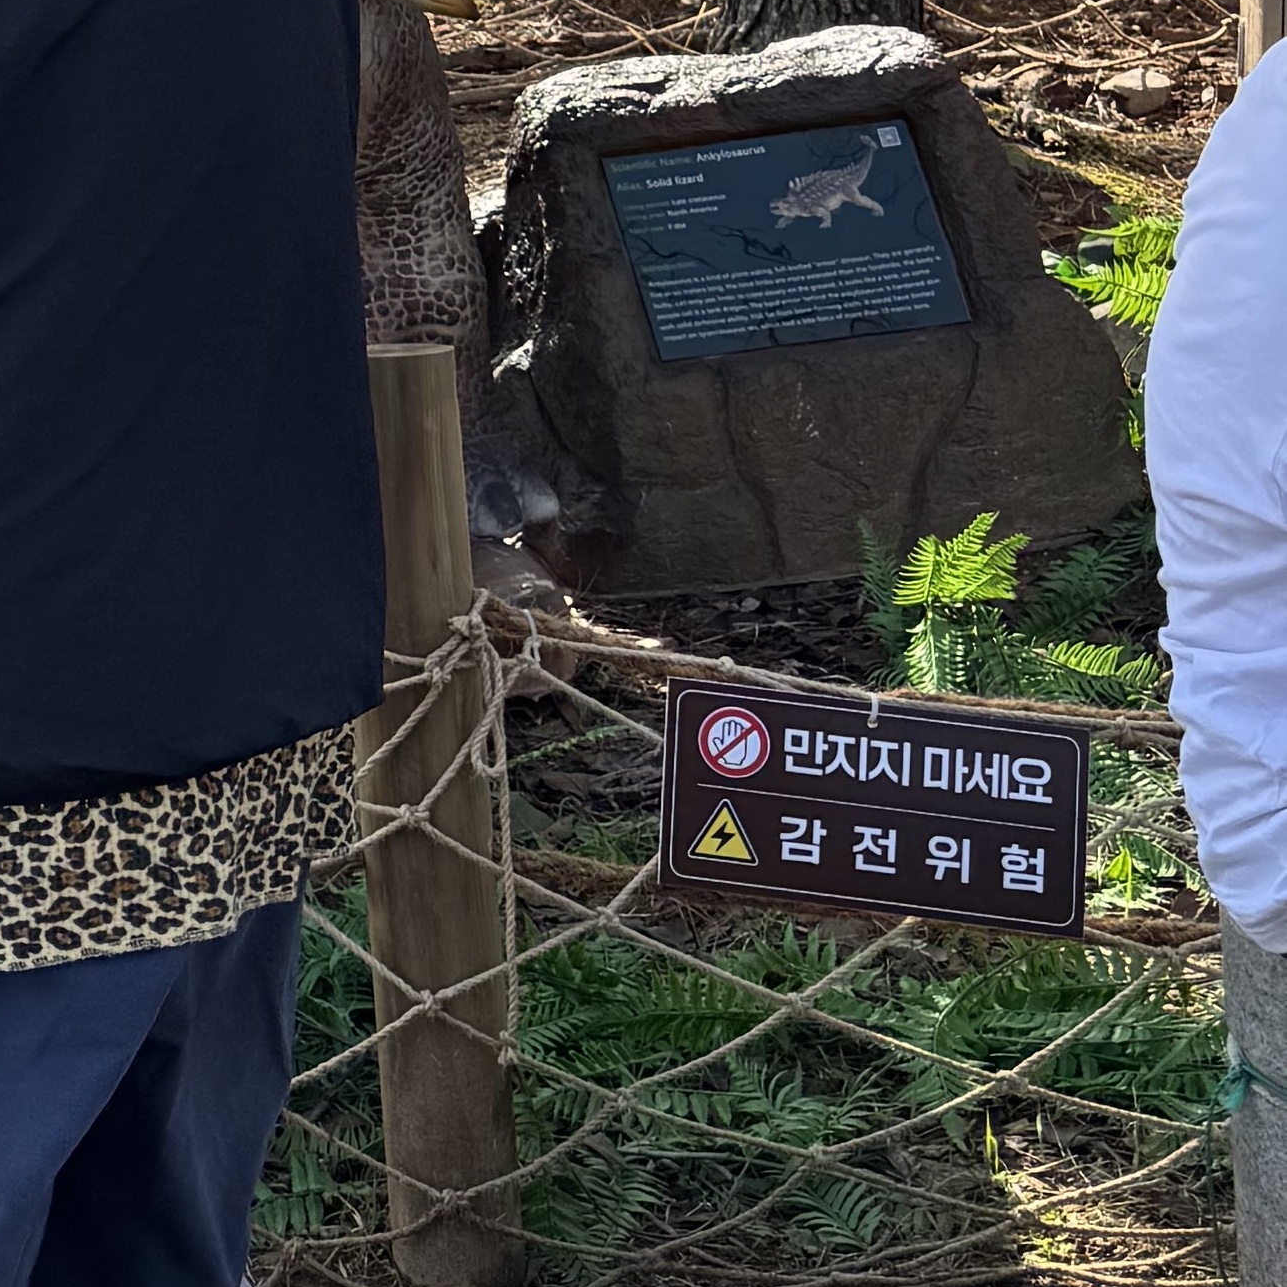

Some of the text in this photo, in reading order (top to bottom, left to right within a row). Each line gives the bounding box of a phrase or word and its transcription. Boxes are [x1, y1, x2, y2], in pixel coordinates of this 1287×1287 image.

[696, 145, 766, 162] Ankylosaurus
[646, 177, 673, 190] Solid
[674, 173, 704, 186] lizard
[783, 727, 1054, 805] 만지지 마세요
